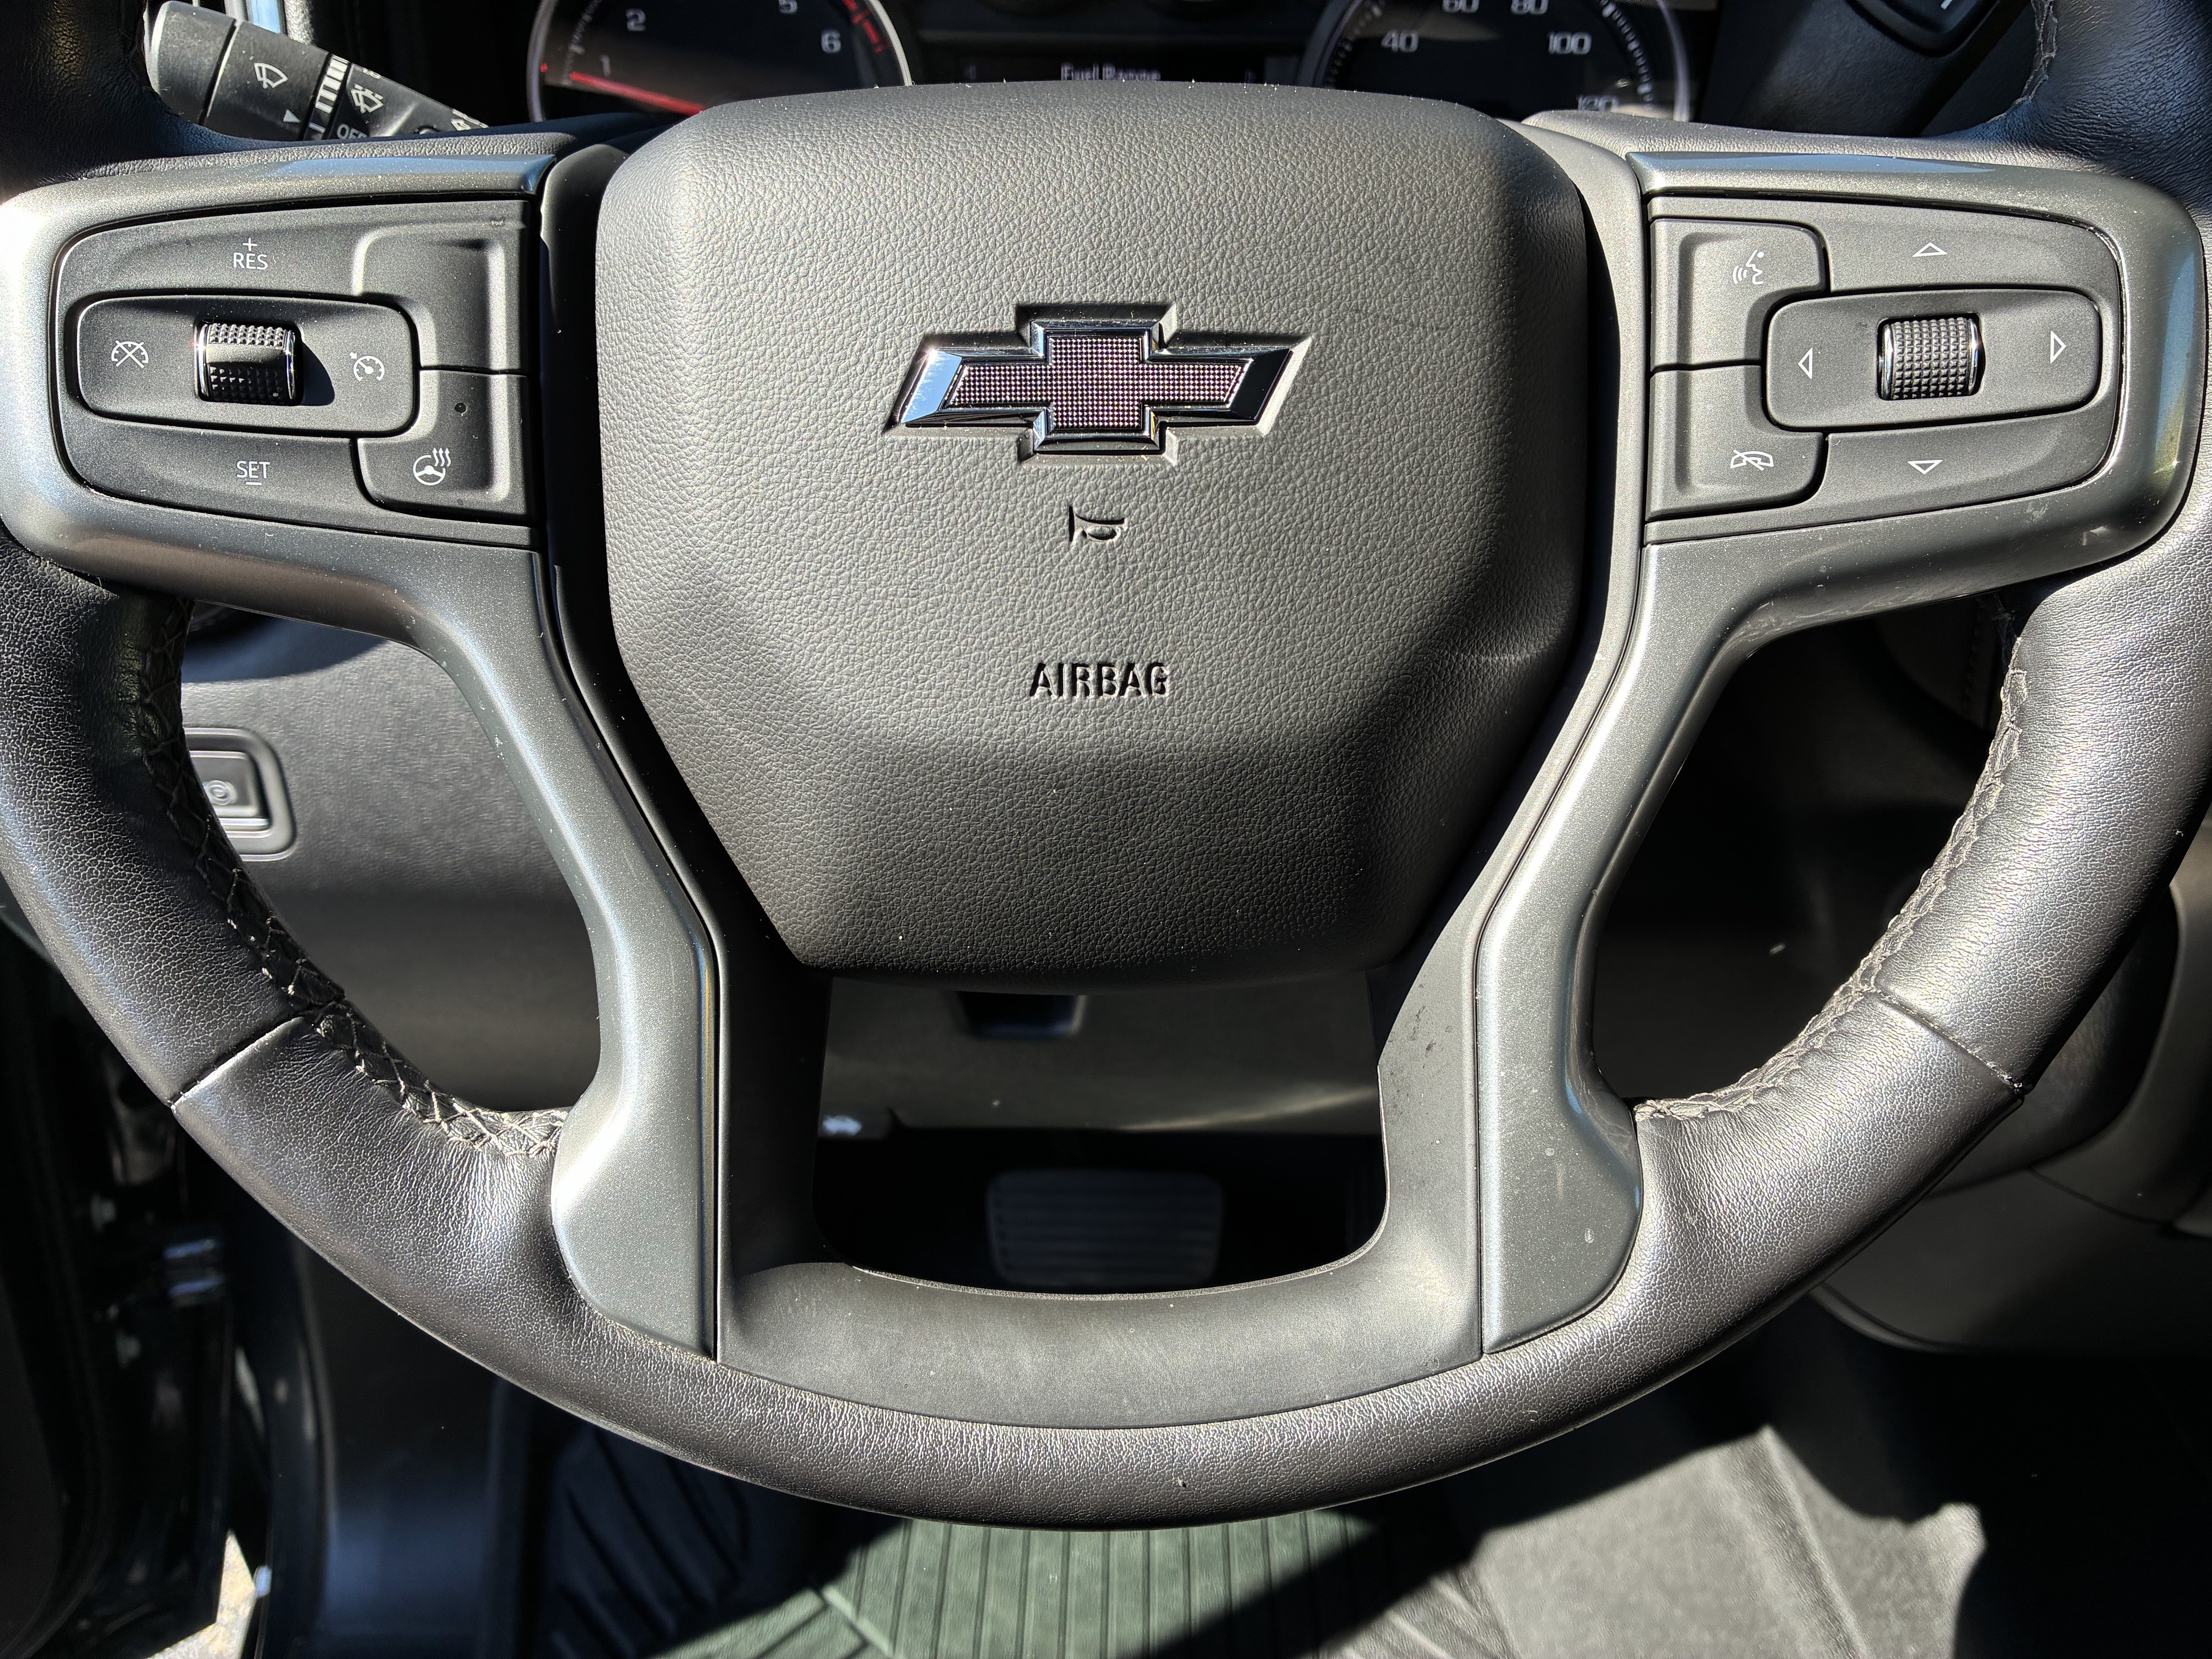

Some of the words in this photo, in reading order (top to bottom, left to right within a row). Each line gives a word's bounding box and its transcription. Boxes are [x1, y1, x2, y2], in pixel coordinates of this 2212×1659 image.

[626, 9, 646, 31] 2
[821, 29, 842, 53] 6
[1381, 29, 1419, 52] 40
[1548, 32, 1592, 54] 100
[600, 55, 611, 77] 1
[233, 252, 268, 270] RES
[237, 460, 270, 479] SET
[1029, 662, 1170, 698] AIRBAG
